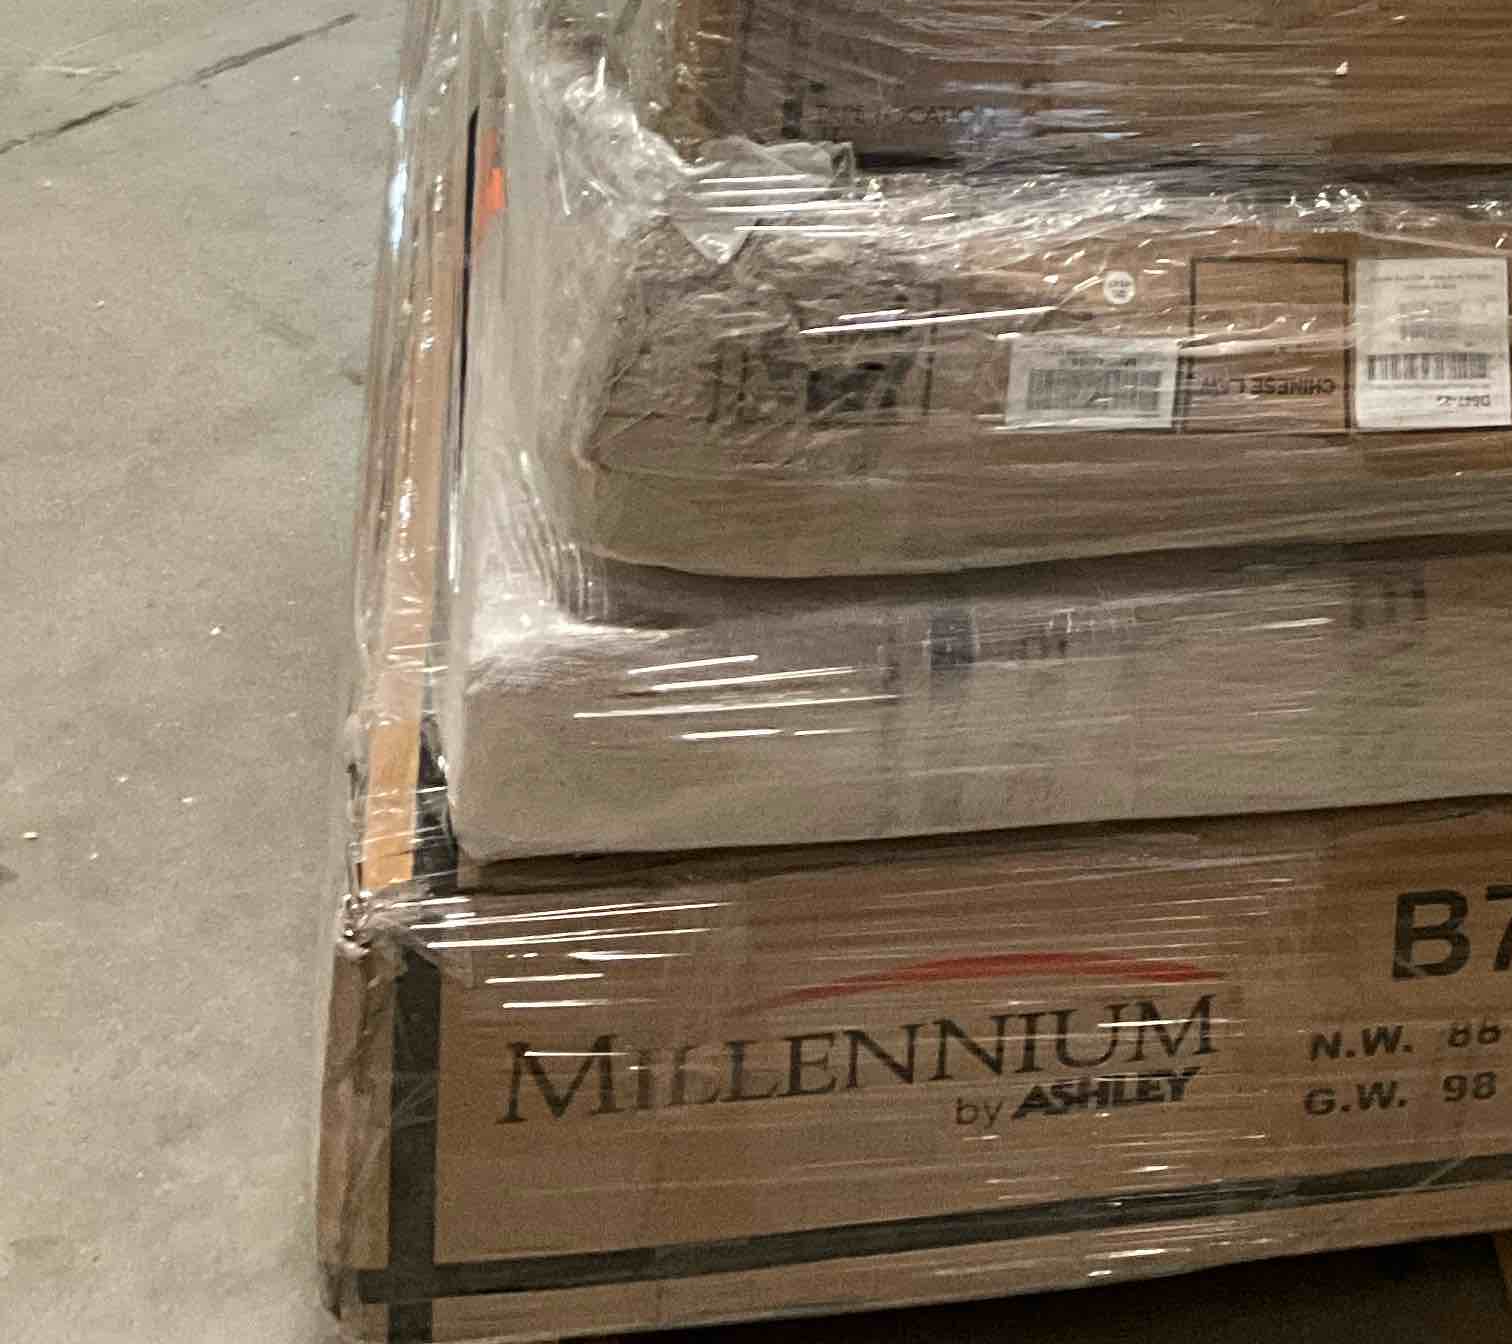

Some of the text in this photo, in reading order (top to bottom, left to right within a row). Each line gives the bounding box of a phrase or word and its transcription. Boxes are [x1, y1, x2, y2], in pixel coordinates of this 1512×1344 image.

[955, 1065, 1202, 1130] by ASHLEY
[1442, 1071, 1498, 1103] 98
